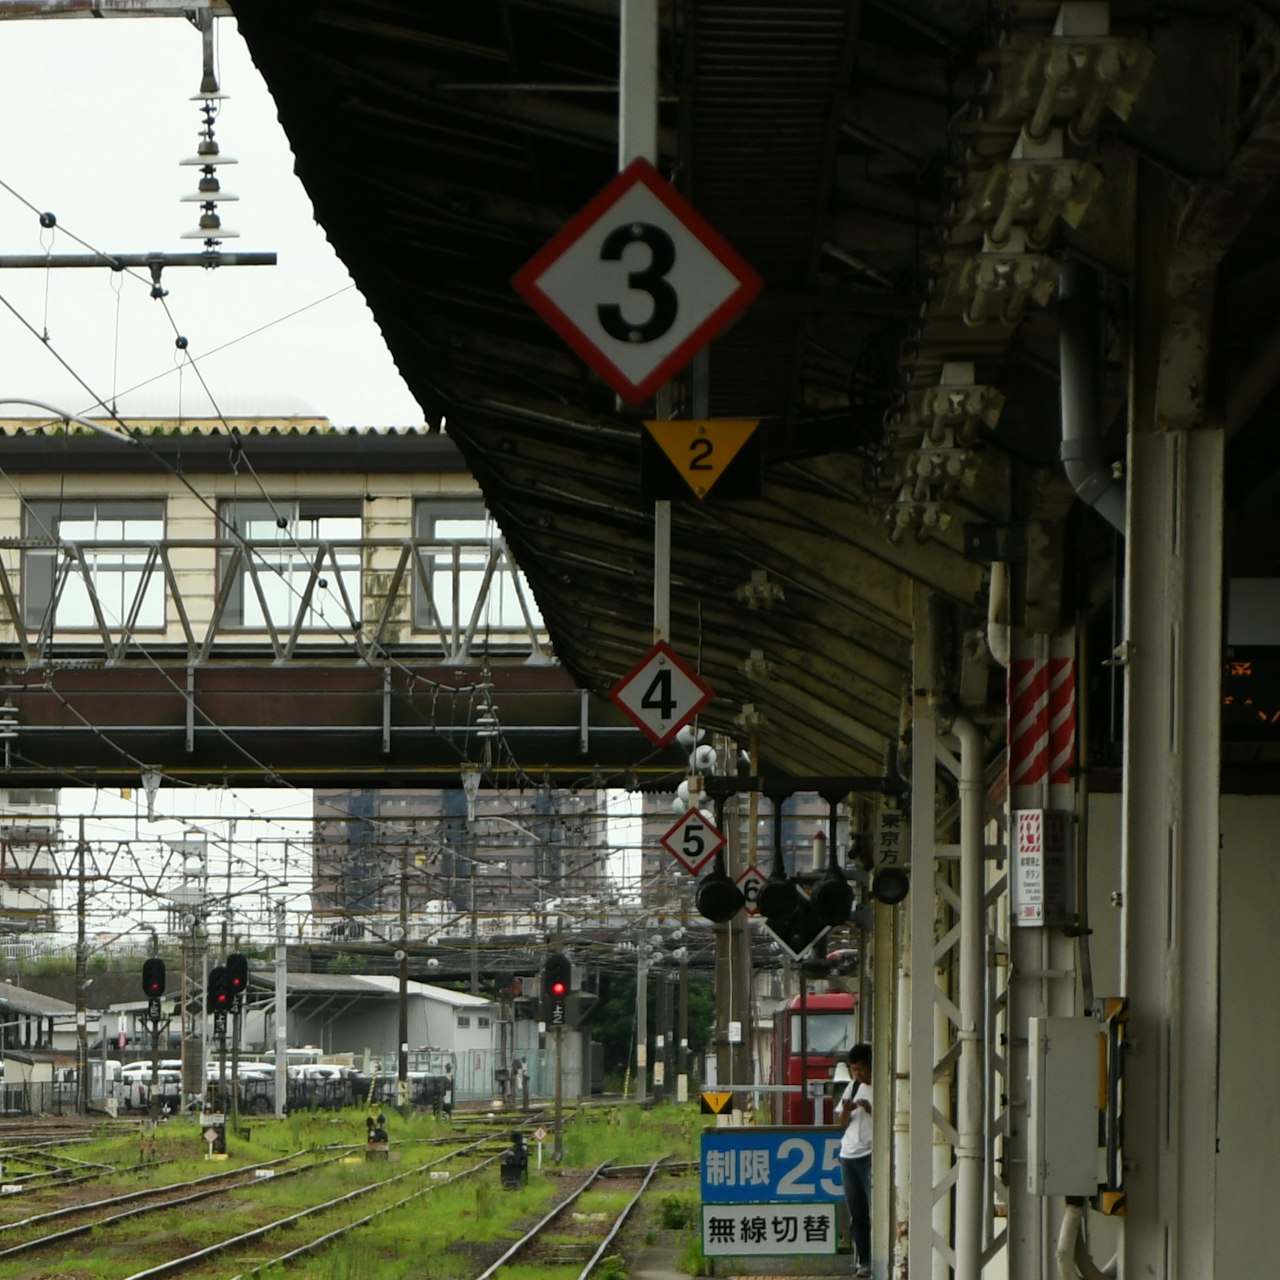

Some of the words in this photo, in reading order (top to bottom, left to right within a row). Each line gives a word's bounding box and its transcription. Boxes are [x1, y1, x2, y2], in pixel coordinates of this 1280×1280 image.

[597, 221, 679, 344] 3
[688, 437, 715, 471] 2
[640, 669, 677, 720] 4
[682, 824, 705, 858] 5
[744, 878, 761, 903] 6
[215, 1015, 226, 1031] 上3
[552, 1004, 564, 1024] 上2
[706, 1148, 770, 1186] 制限
[776, 1137, 845, 1196] 25
[708, 1214, 830, 1244] 無線切替
